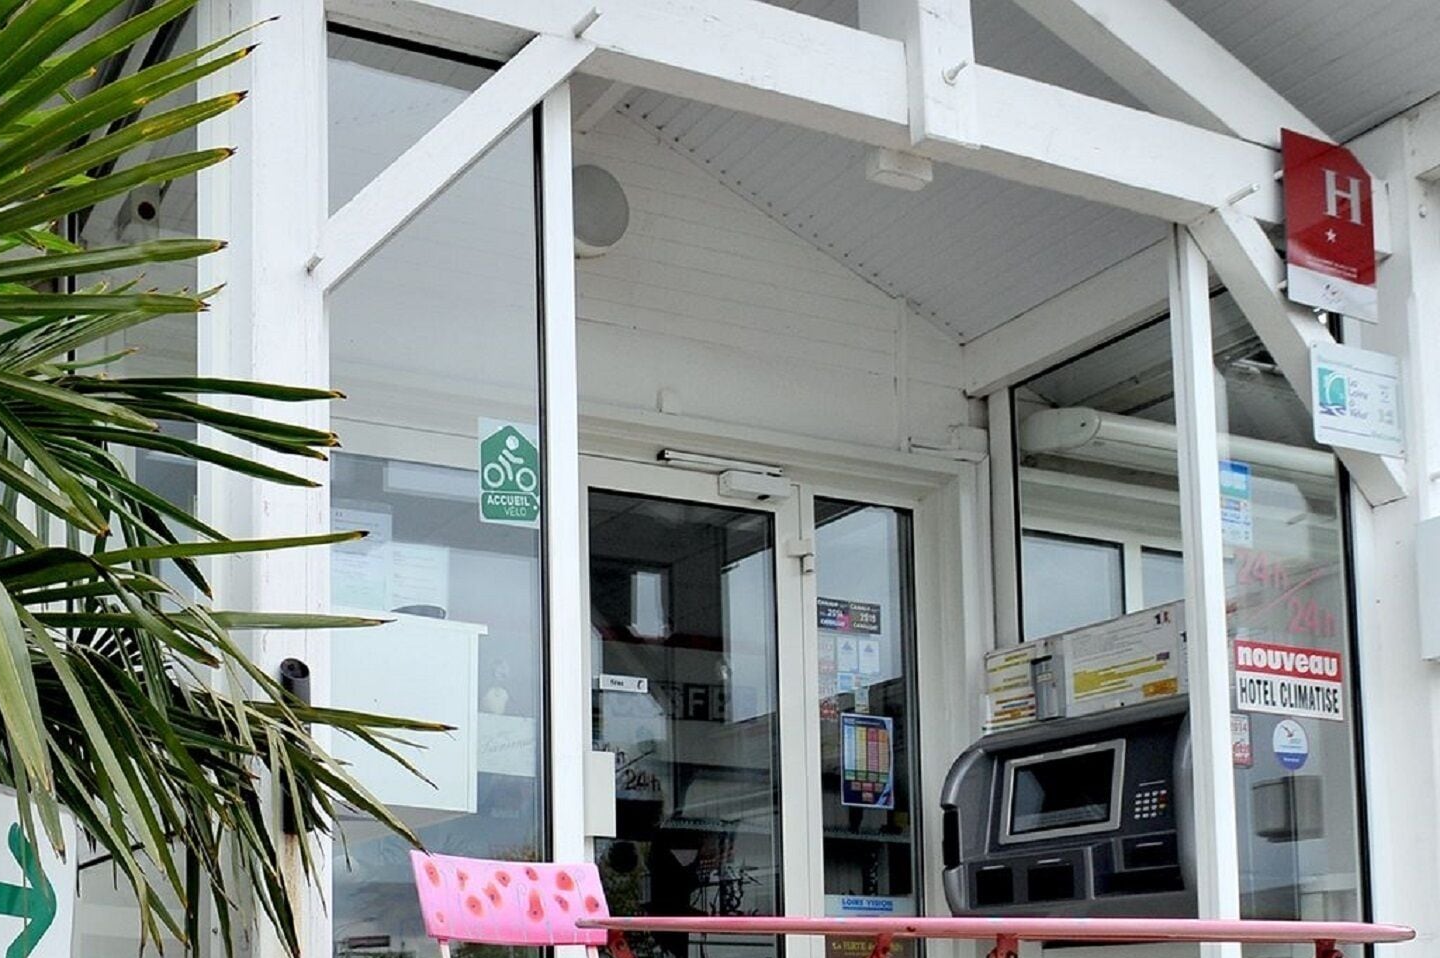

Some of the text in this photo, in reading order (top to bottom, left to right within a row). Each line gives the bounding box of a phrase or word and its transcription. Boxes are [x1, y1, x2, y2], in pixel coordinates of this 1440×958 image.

[1323, 169, 1364, 226] H
[487, 495, 530, 507] ACCUEIL
[1236, 645, 1338, 677] nouveau
[1239, 678, 1340, 714] HOTEL CLIMATISE
